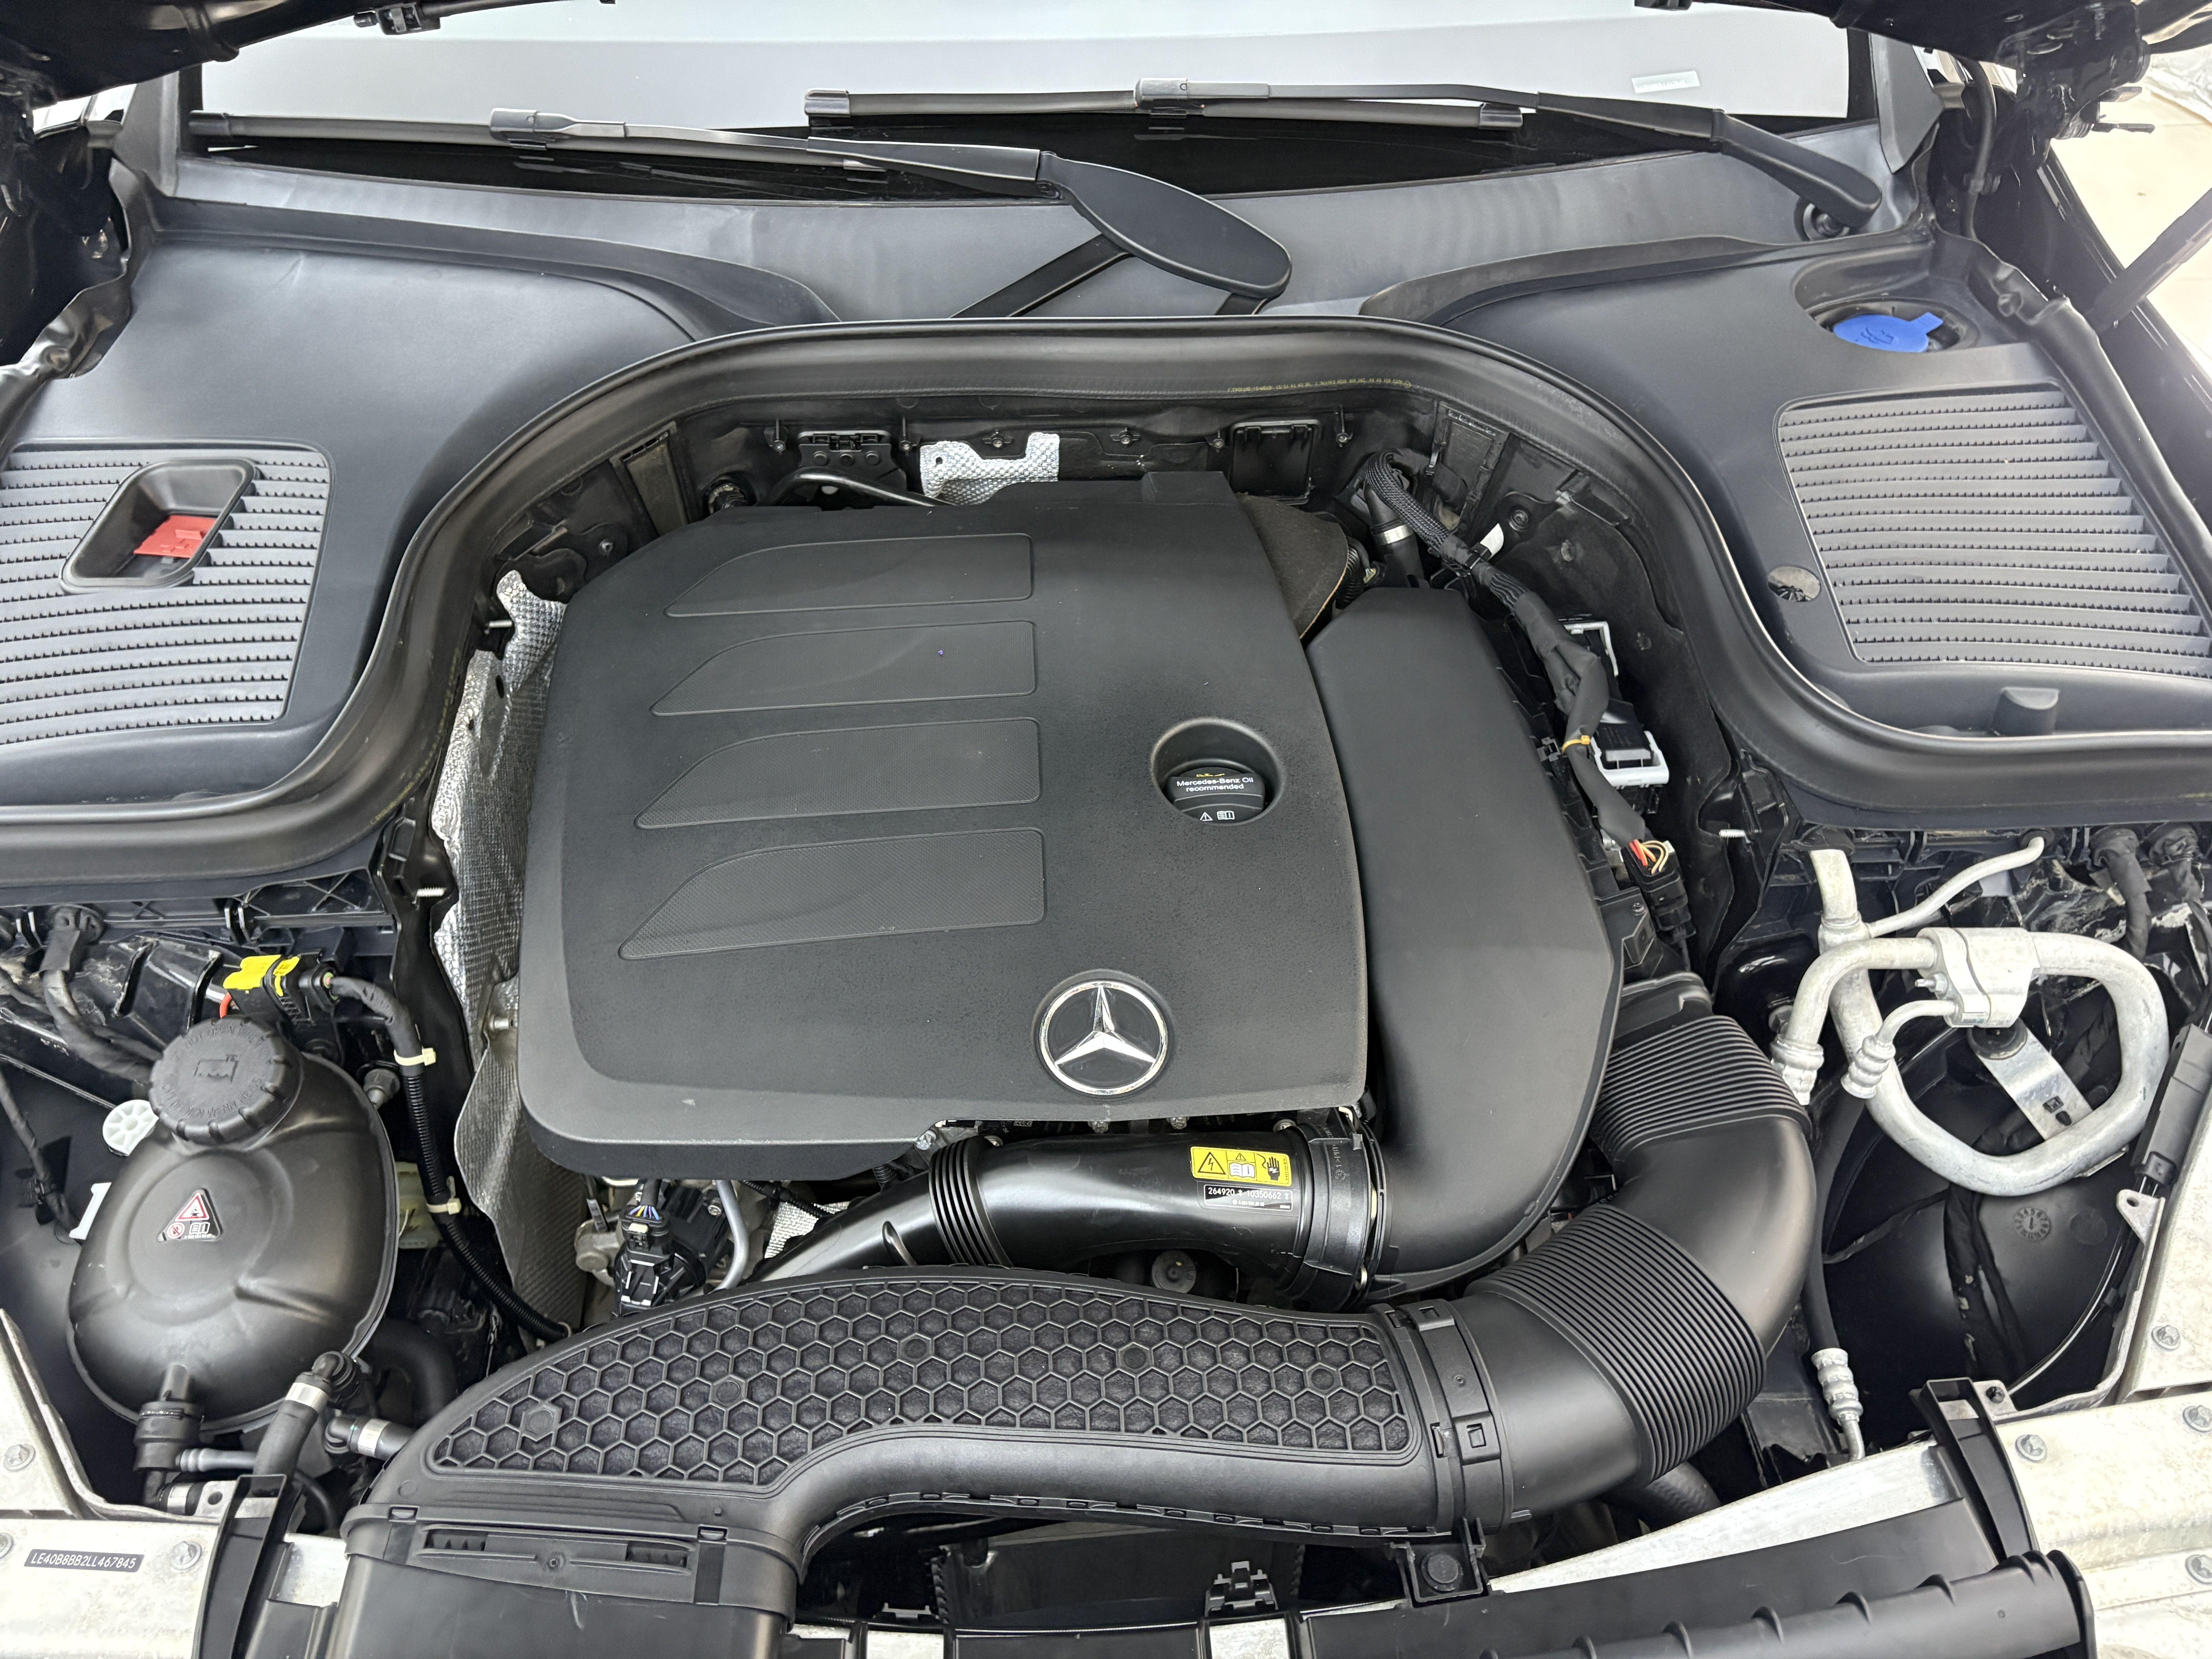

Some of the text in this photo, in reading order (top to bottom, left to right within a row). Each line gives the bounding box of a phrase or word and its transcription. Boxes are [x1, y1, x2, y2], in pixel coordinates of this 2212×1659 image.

[1176, 778, 1240, 787] Mercedes-Benz
[1186, 783, 1244, 792] recommended
[1208, 1187, 1281, 1200] 264920 10350662
[30, 1552, 137, 1569] LE40B8BB2LL467845
